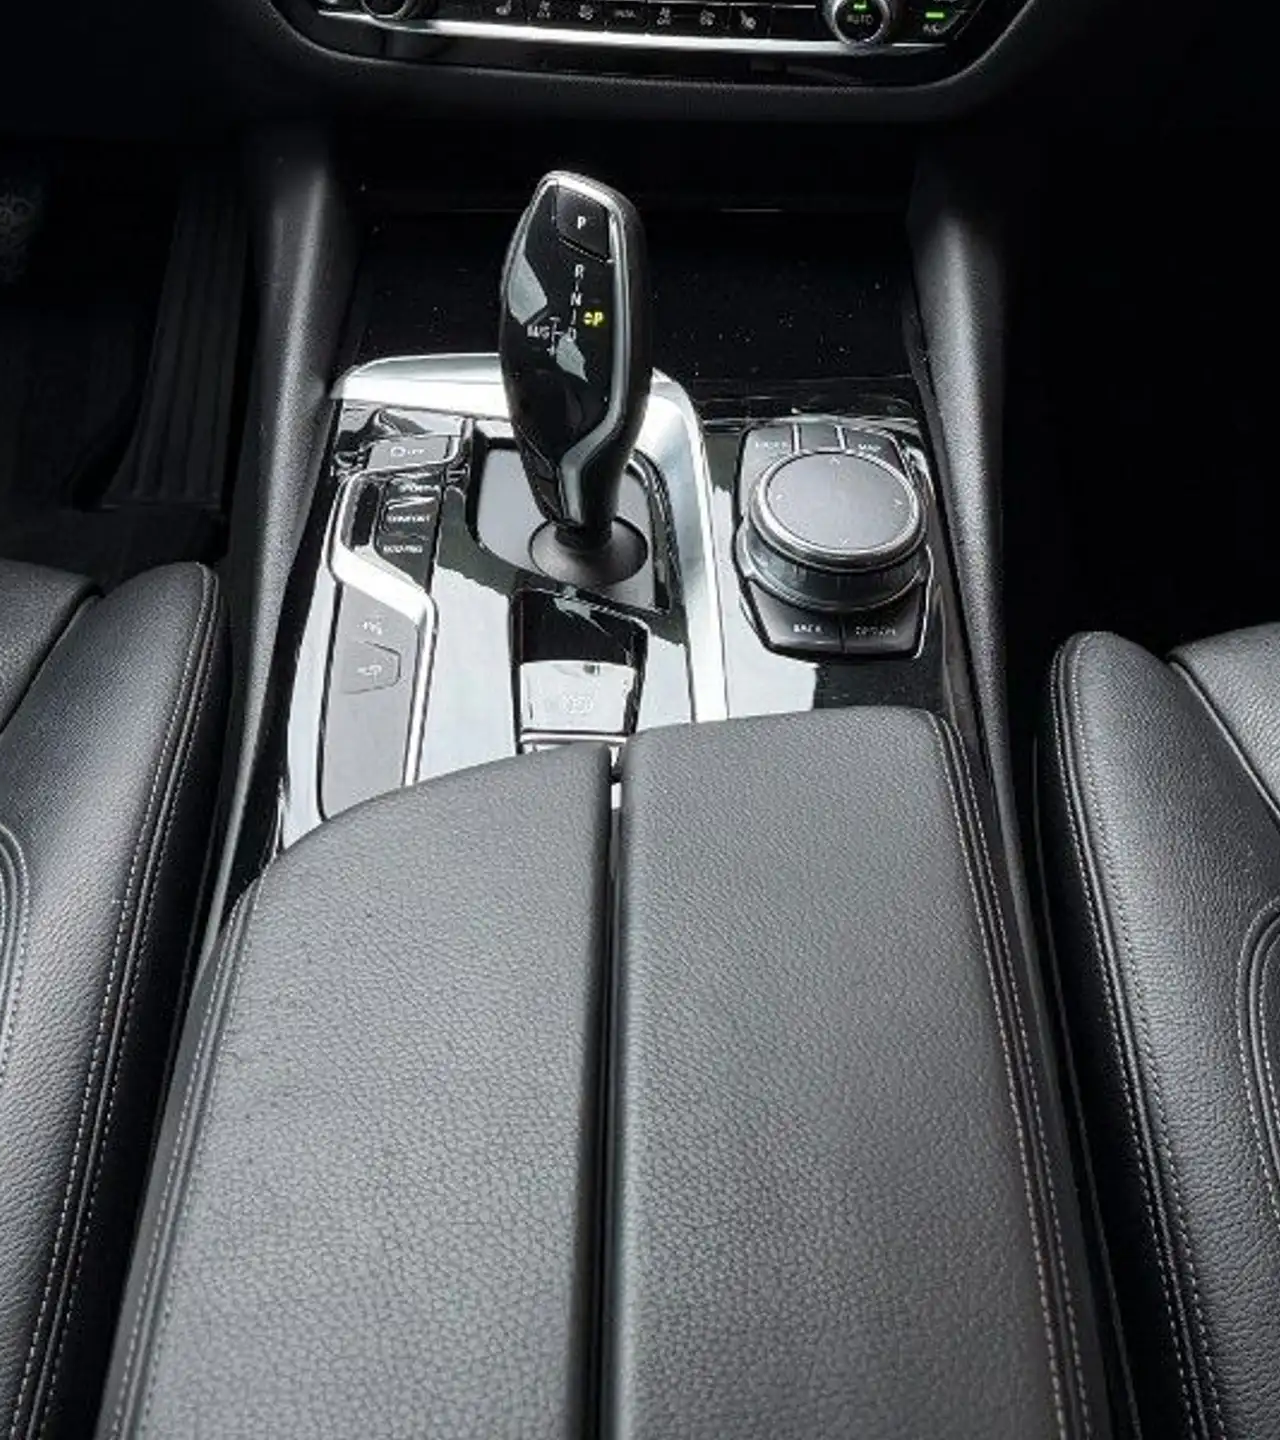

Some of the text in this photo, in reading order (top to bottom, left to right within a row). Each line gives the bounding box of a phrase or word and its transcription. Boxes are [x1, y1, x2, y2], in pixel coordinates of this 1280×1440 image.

[577, 215, 587, 230] P
[575, 263, 585, 279] R
[570, 291, 582, 307] N
